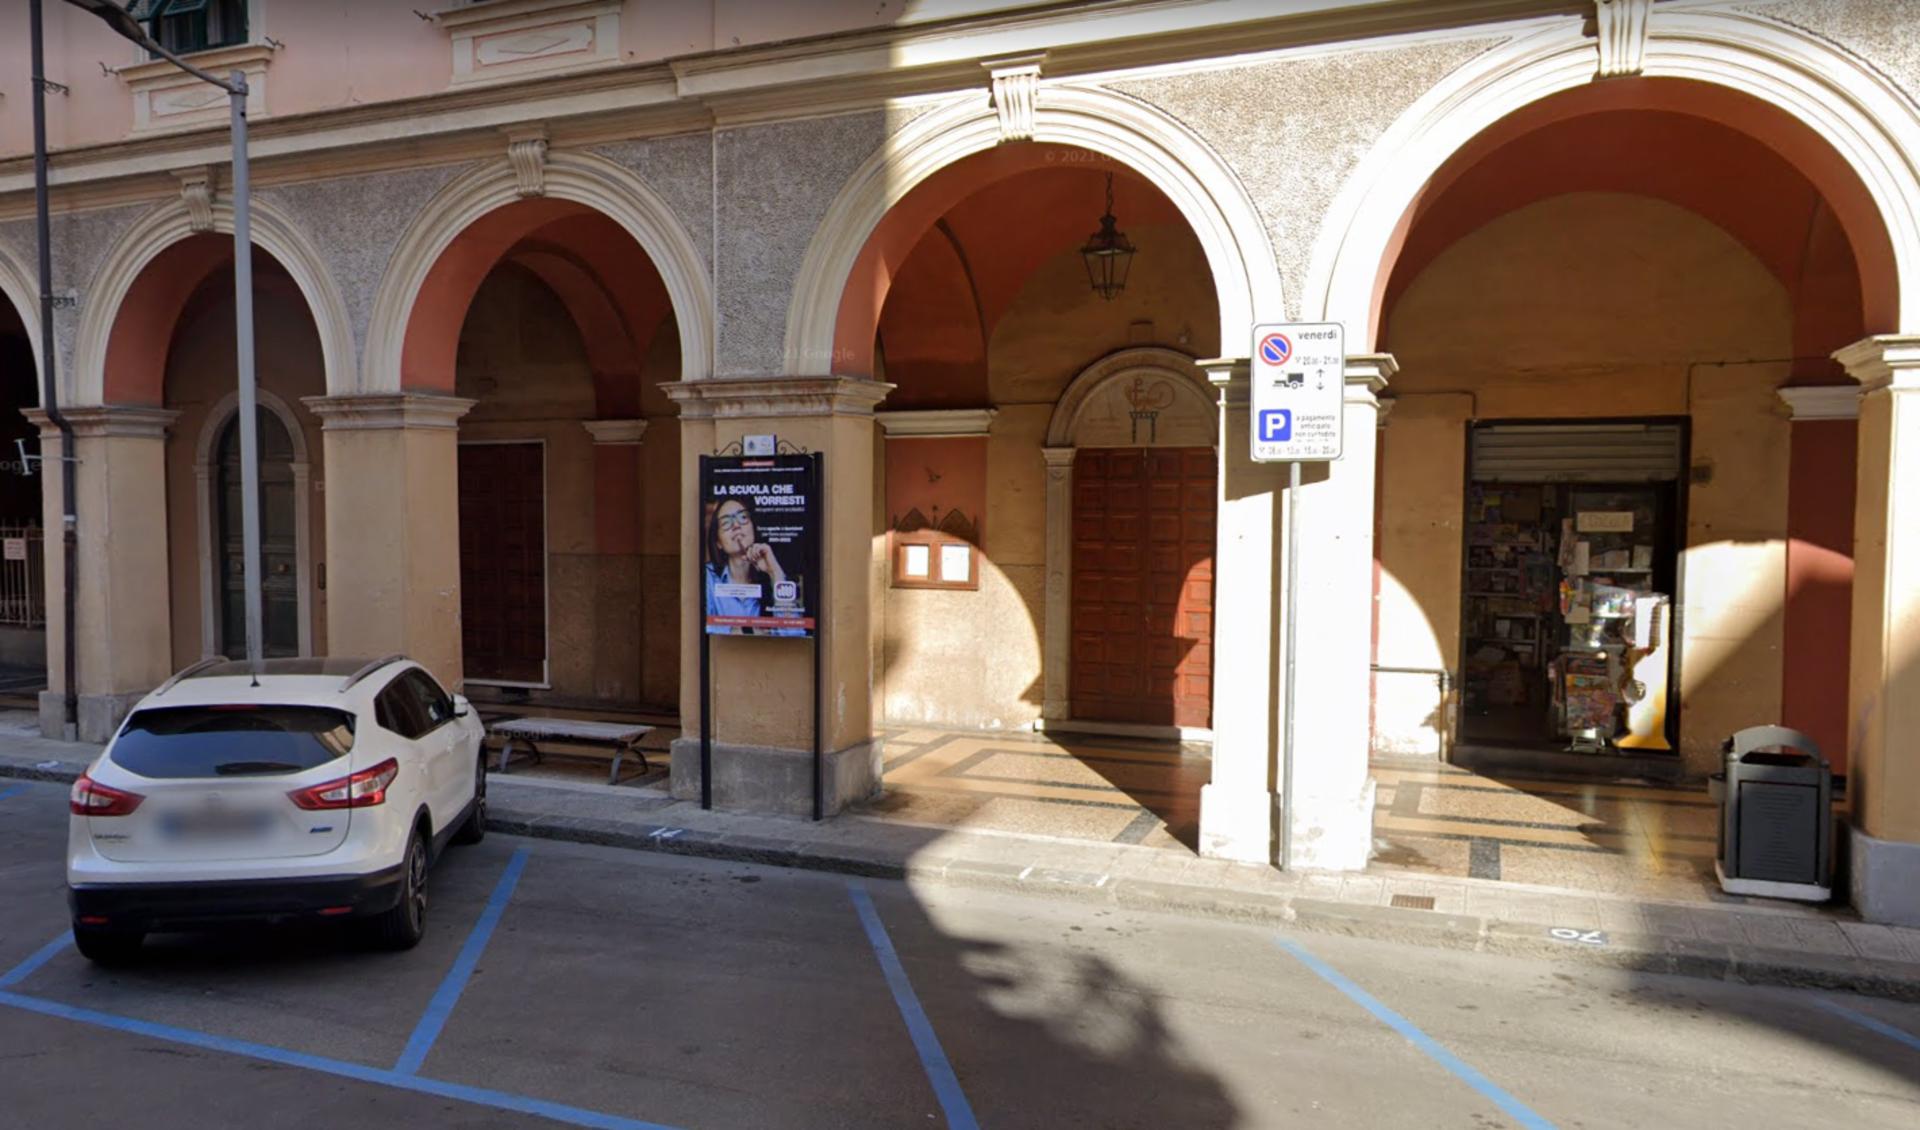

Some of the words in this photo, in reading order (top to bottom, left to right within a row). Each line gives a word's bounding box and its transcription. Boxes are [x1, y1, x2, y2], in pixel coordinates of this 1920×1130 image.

[1265, 412, 1286, 439] P
[713, 485, 727, 495] LA
[729, 484, 770, 495] SCUOLA
[771, 484, 794, 494] CHE
[754, 495, 805, 506] VORRESTI
